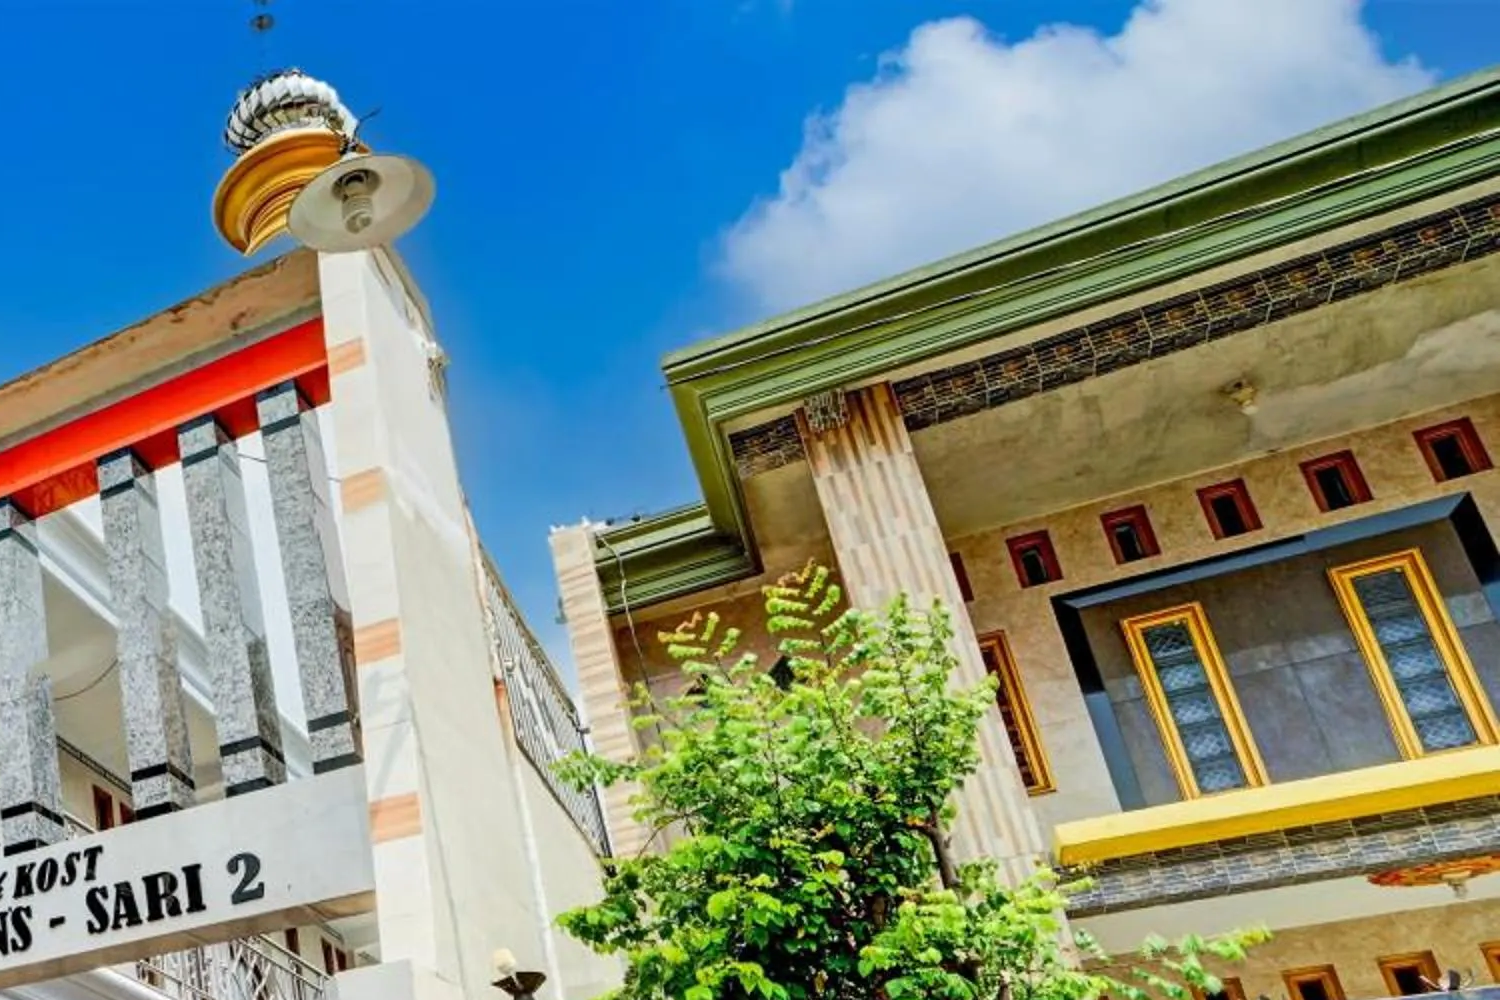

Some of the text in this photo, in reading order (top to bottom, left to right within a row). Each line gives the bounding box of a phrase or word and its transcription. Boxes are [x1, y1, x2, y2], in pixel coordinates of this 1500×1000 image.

[12, 845, 104, 898] KOST
[85, 863, 206, 935] SARI
[225, 852, 265, 905] 2
